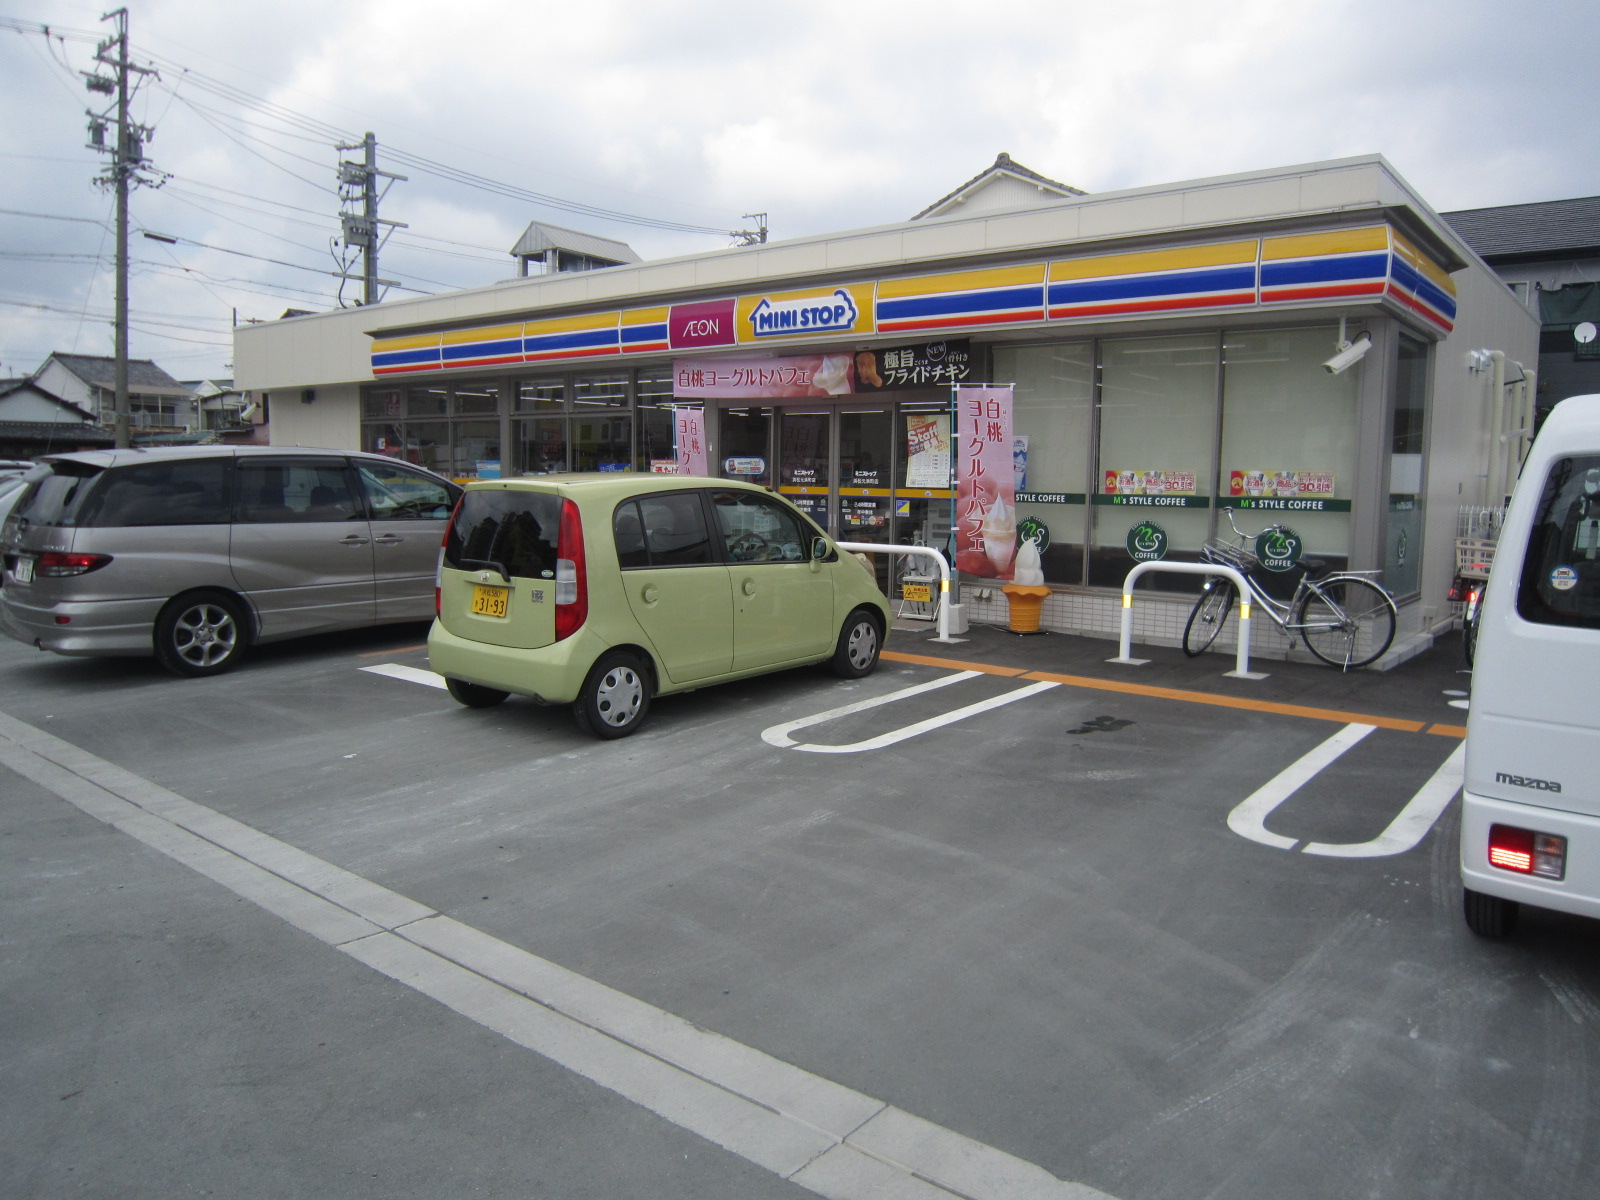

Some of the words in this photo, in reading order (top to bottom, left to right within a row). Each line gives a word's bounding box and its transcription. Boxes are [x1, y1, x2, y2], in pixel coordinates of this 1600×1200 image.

[759, 308, 798, 331] MINI
[799, 304, 847, 327] STOP
[884, 348, 915, 370] 極旨
[927, 344, 945, 356] NEW
[678, 366, 811, 389] 白桃ヨーグルトパフェ
[884, 363, 971, 387] フライドチキン
[986, 397, 1004, 444] 白桃
[689, 418, 702, 456] 白桃
[907, 423, 939, 447] Staff
[966, 399, 986, 553] ヨーグルトパフェ
[1015, 493, 1037, 503] STYLE
[1038, 493, 1066, 504] COFFEE
[1113, 495, 1127, 505] M's
[1129, 496, 1153, 506] STYLE
[1155, 497, 1186, 507] COFFEE
[1240, 498, 1256, 509] M's
[1258, 499, 1286, 510] STYLE
[1288, 500, 1324, 511] COFFEE
[1134, 551, 1159, 560] COFFEE
[1264, 558, 1292, 568] COFFEE
